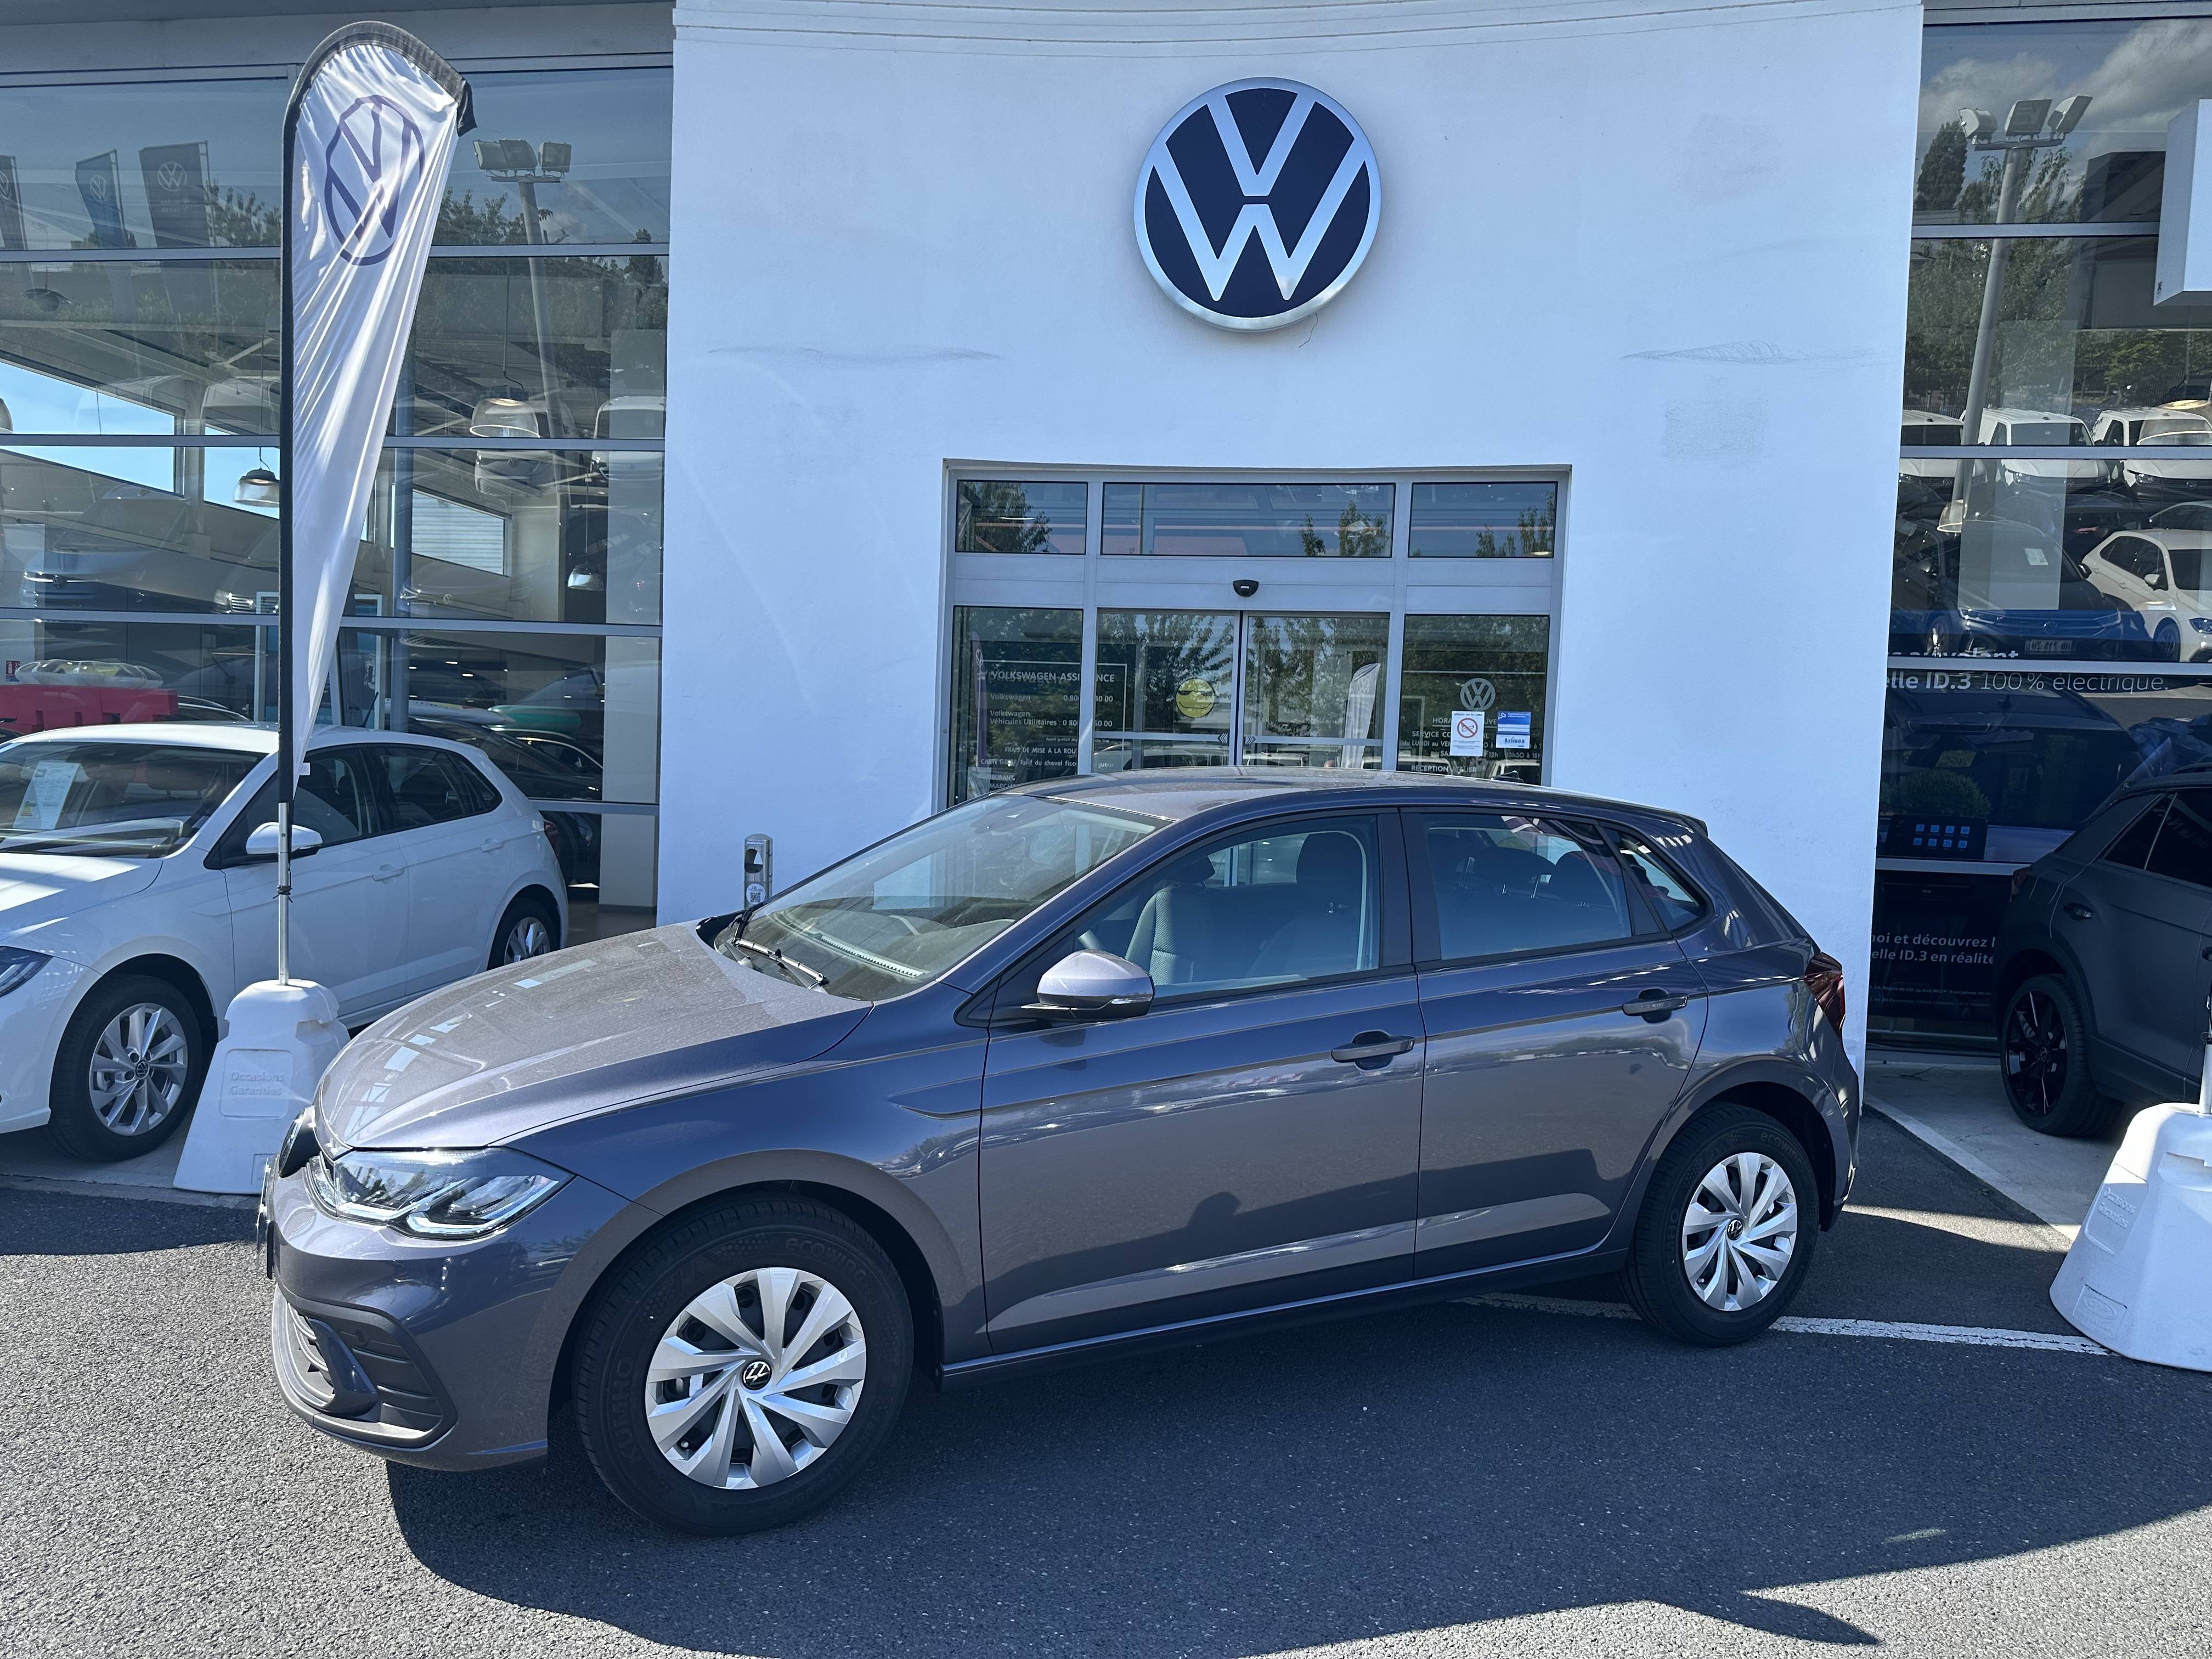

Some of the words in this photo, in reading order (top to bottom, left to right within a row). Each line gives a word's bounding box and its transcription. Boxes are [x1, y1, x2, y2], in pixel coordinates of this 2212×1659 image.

[992, 670, 1056, 681] VOLKSWAGEN
[1926, 672, 1971, 690] ID.3
[1981, 672, 2023, 690] 100
[2027, 673, 2045, 690] %
[2053, 673, 2169, 695] électrique.
[990, 693, 1030, 702] Volkswagen
[990, 710, 1030, 718] Volkswagen
[1023, 718, 1057, 726] Utilitaires
[1894, 934, 1909, 945] et
[1912, 934, 1988, 947] découvrez
[1899, 950, 1927, 962] ID.3
[1931, 953, 1948, 963] en
[230, 1072, 285, 1082] Occasions
[229, 1085, 282, 1096] Garanties
